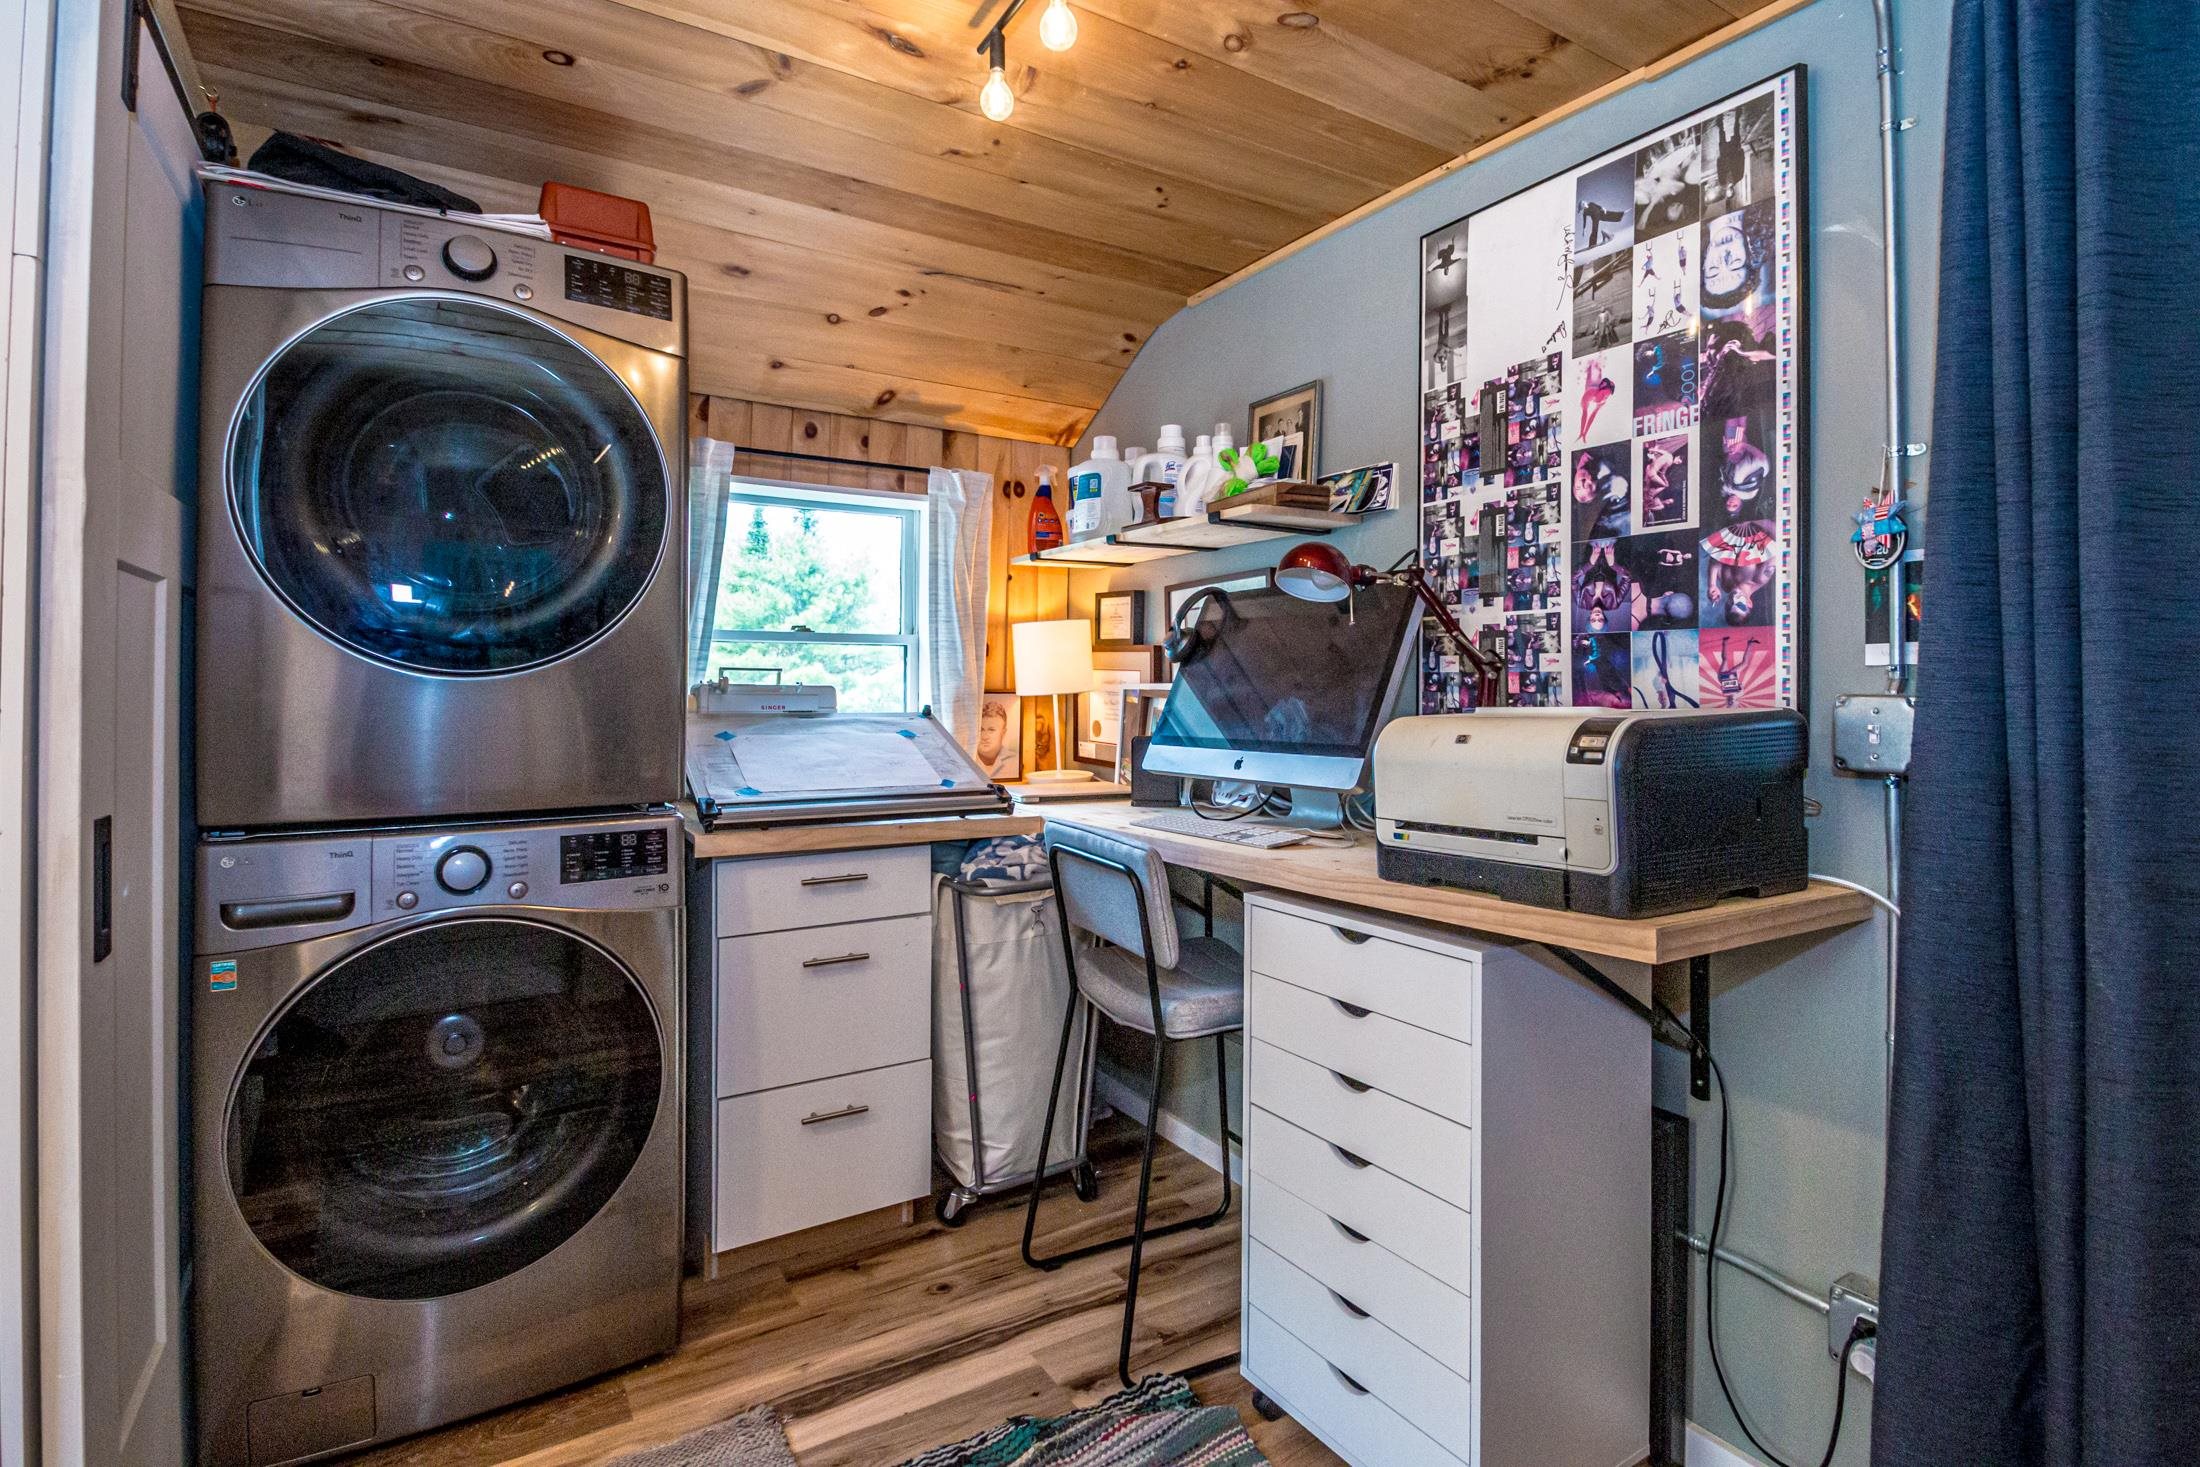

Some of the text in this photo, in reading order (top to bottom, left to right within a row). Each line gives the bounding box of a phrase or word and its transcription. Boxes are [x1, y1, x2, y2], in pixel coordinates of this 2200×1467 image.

[1681, 362, 1695, 405] 2001
[1633, 404, 1699, 438] FRINGE
[329, 850, 354, 859] ThinQ
